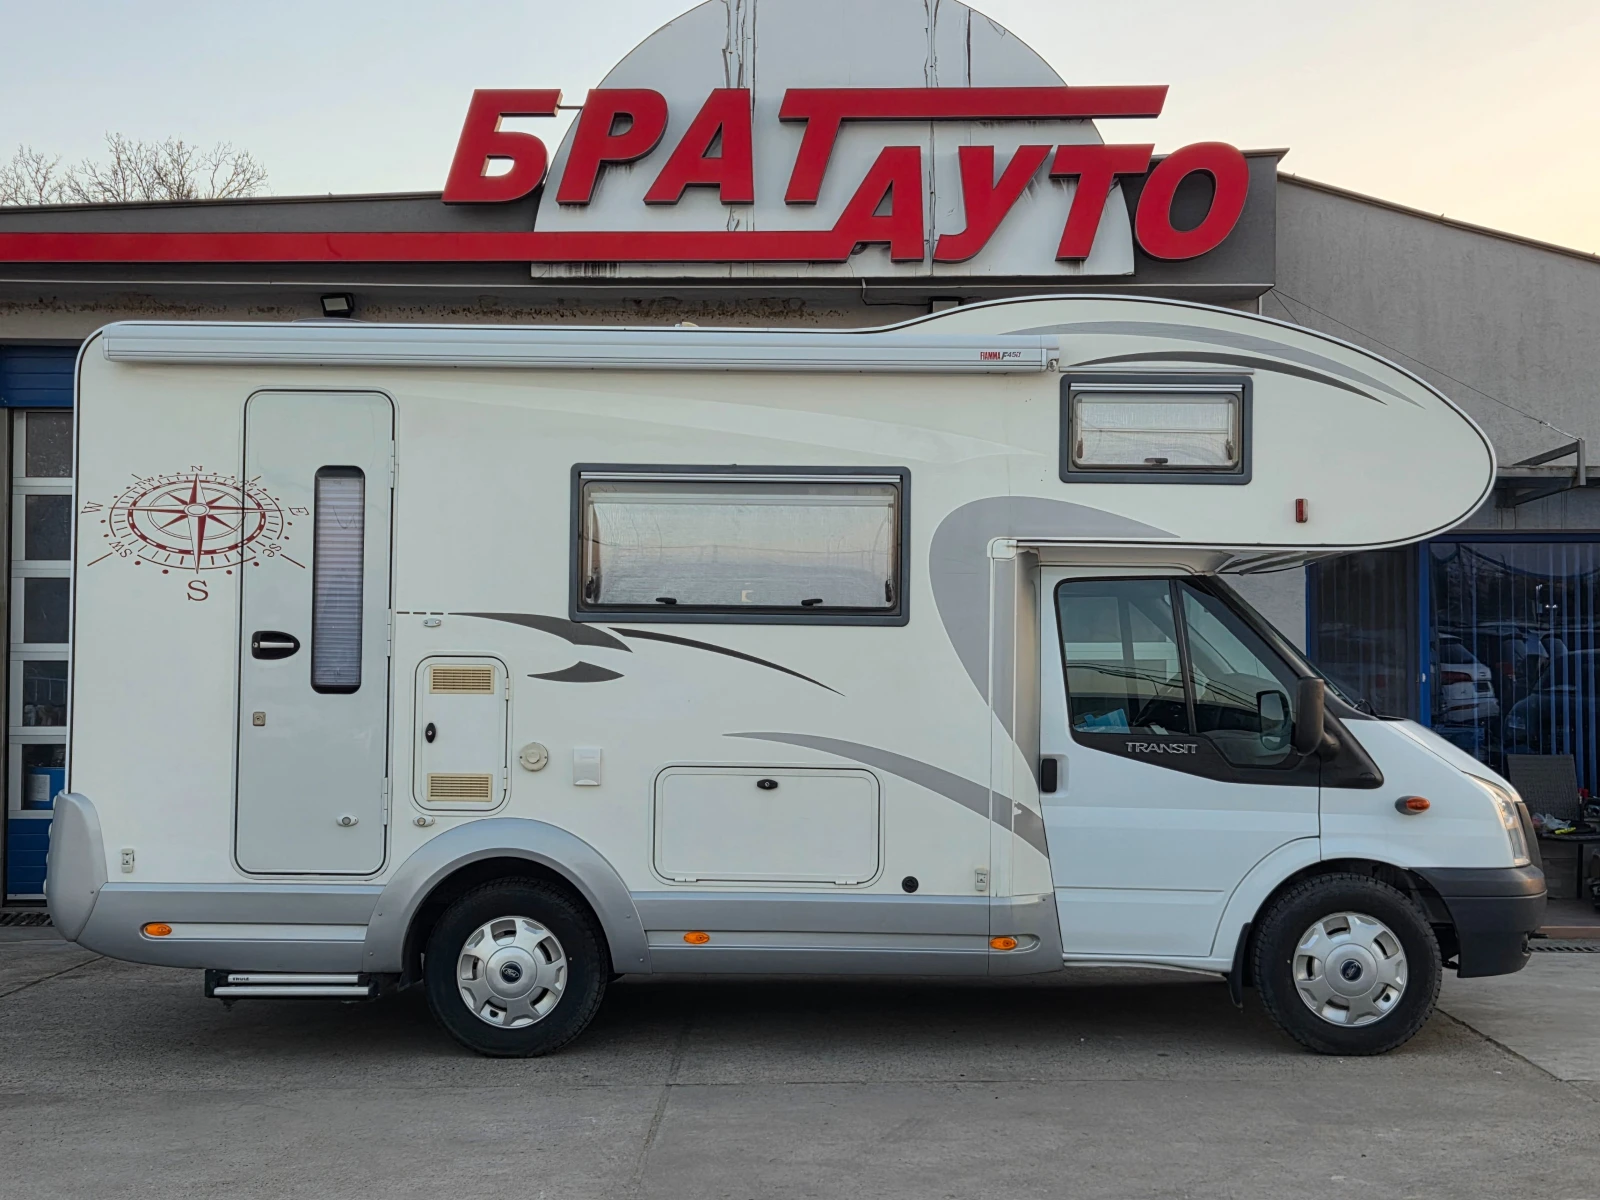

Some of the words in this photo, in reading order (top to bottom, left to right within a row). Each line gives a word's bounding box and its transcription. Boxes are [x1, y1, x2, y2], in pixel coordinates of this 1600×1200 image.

[443, 85, 1168, 205] БРАТ
[830, 142, 1250, 264] АУТО
[287, 506, 310, 516] E
[187, 579, 209, 601] S
[1125, 741, 1199, 754] TRANSIT
